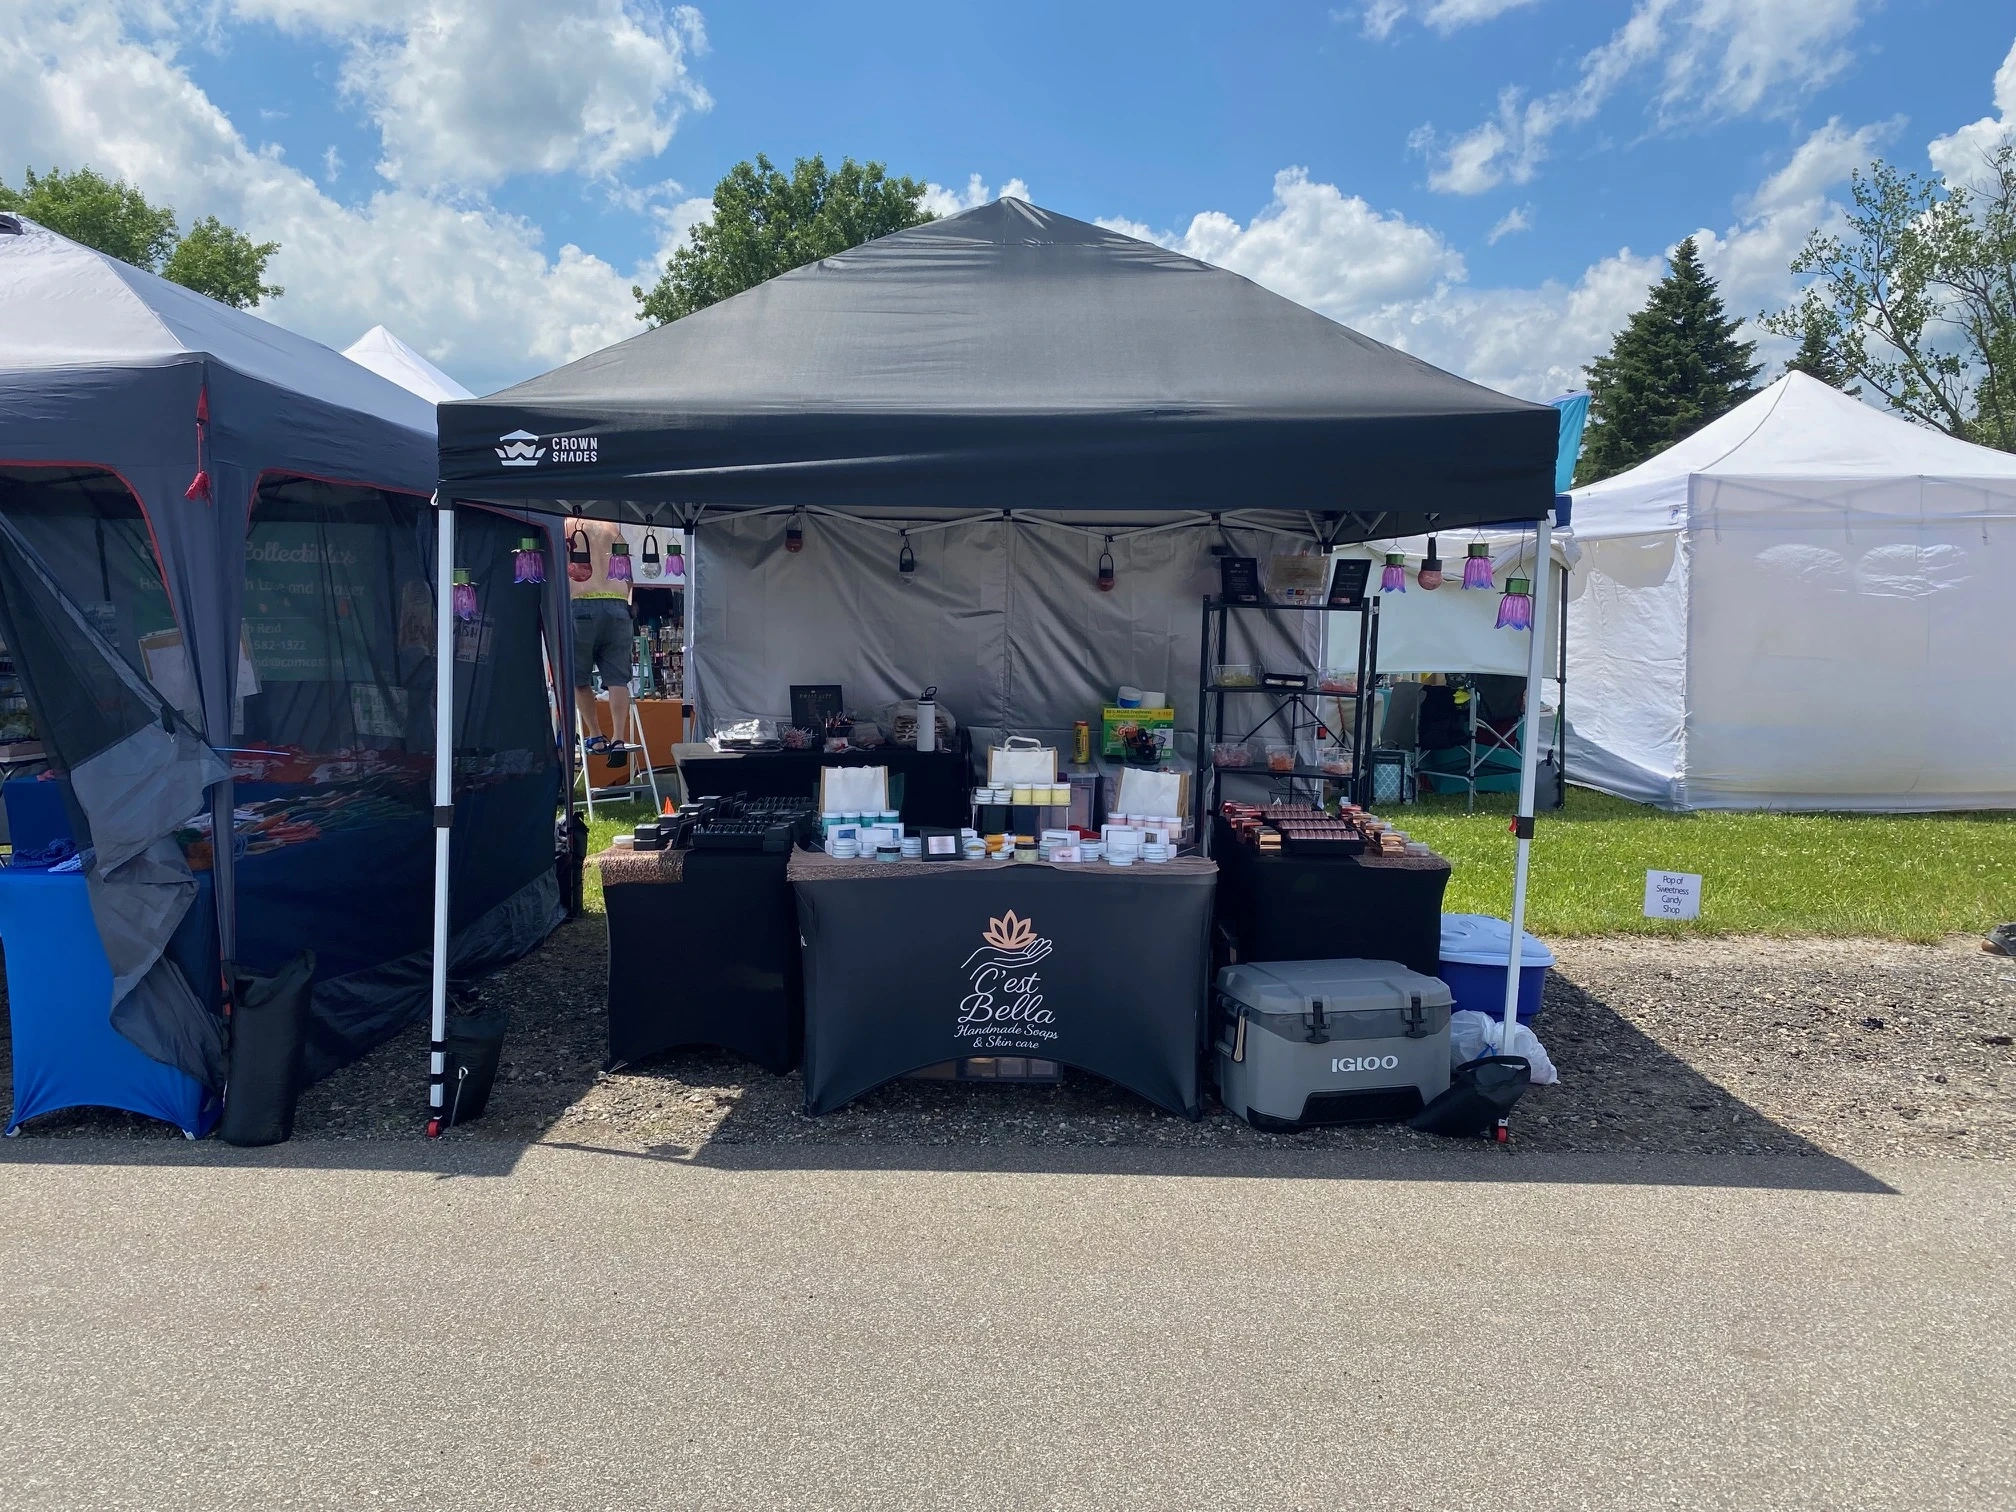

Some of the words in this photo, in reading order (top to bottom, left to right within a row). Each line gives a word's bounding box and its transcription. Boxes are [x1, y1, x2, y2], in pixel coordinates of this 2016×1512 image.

[552, 437, 598, 450] CROWN
[552, 451, 598, 462] SHADES
[1662, 875, 1675, 886] Pop
[1676, 876, 1684, 885] of
[1656, 885, 1689, 896] Sweetness
[1661, 895, 1682, 906] Candy
[1663, 905, 1680, 915] Shop
[975, 968, 1041, 994] C'est
[957, 993, 1056, 1023] Bella
[954, 1023, 1022, 1037] Handmade
[1024, 1023, 1059, 1040] Soaps
[973, 1037, 983, 1048] &
[985, 1035, 1013, 1048] Skin
[1015, 1040, 1040, 1049] care
[1331, 1055, 1399, 1073] IGLOO
